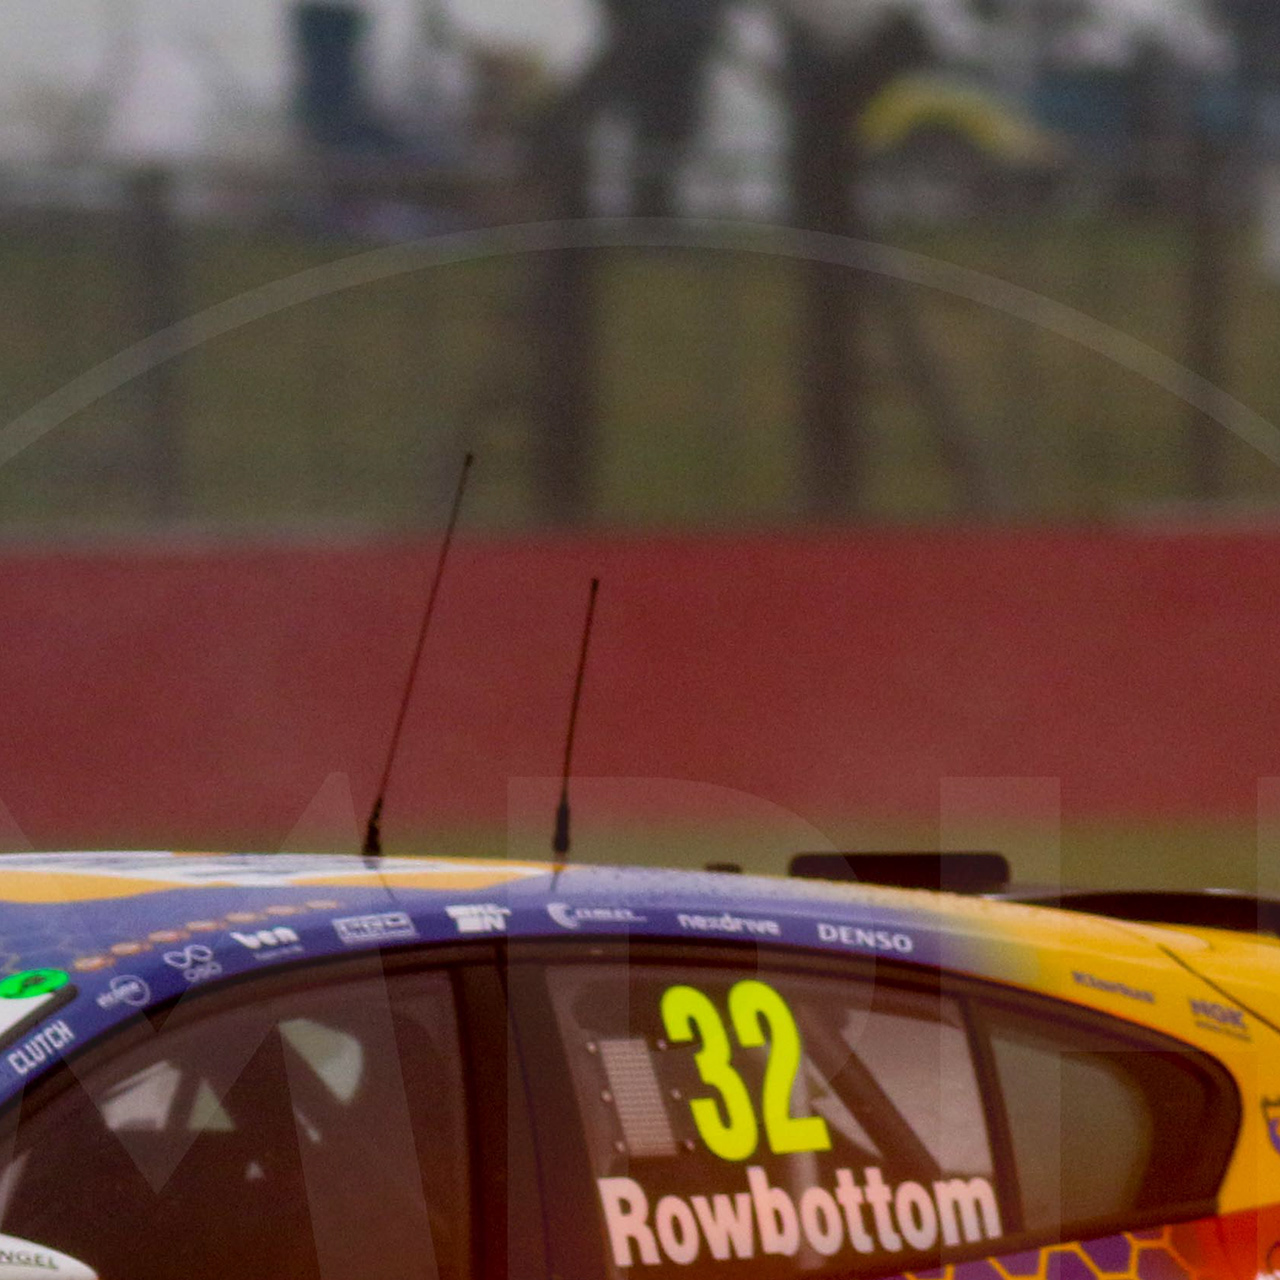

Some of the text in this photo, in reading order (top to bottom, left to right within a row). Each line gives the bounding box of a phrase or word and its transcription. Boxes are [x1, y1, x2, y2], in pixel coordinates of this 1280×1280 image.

[817, 923, 914, 953] DENSO
[7, 1019, 76, 1076] CLUTCH
[661, 979, 832, 1161] 32
[597, 1165, 1003, 1269] Rowbottom
